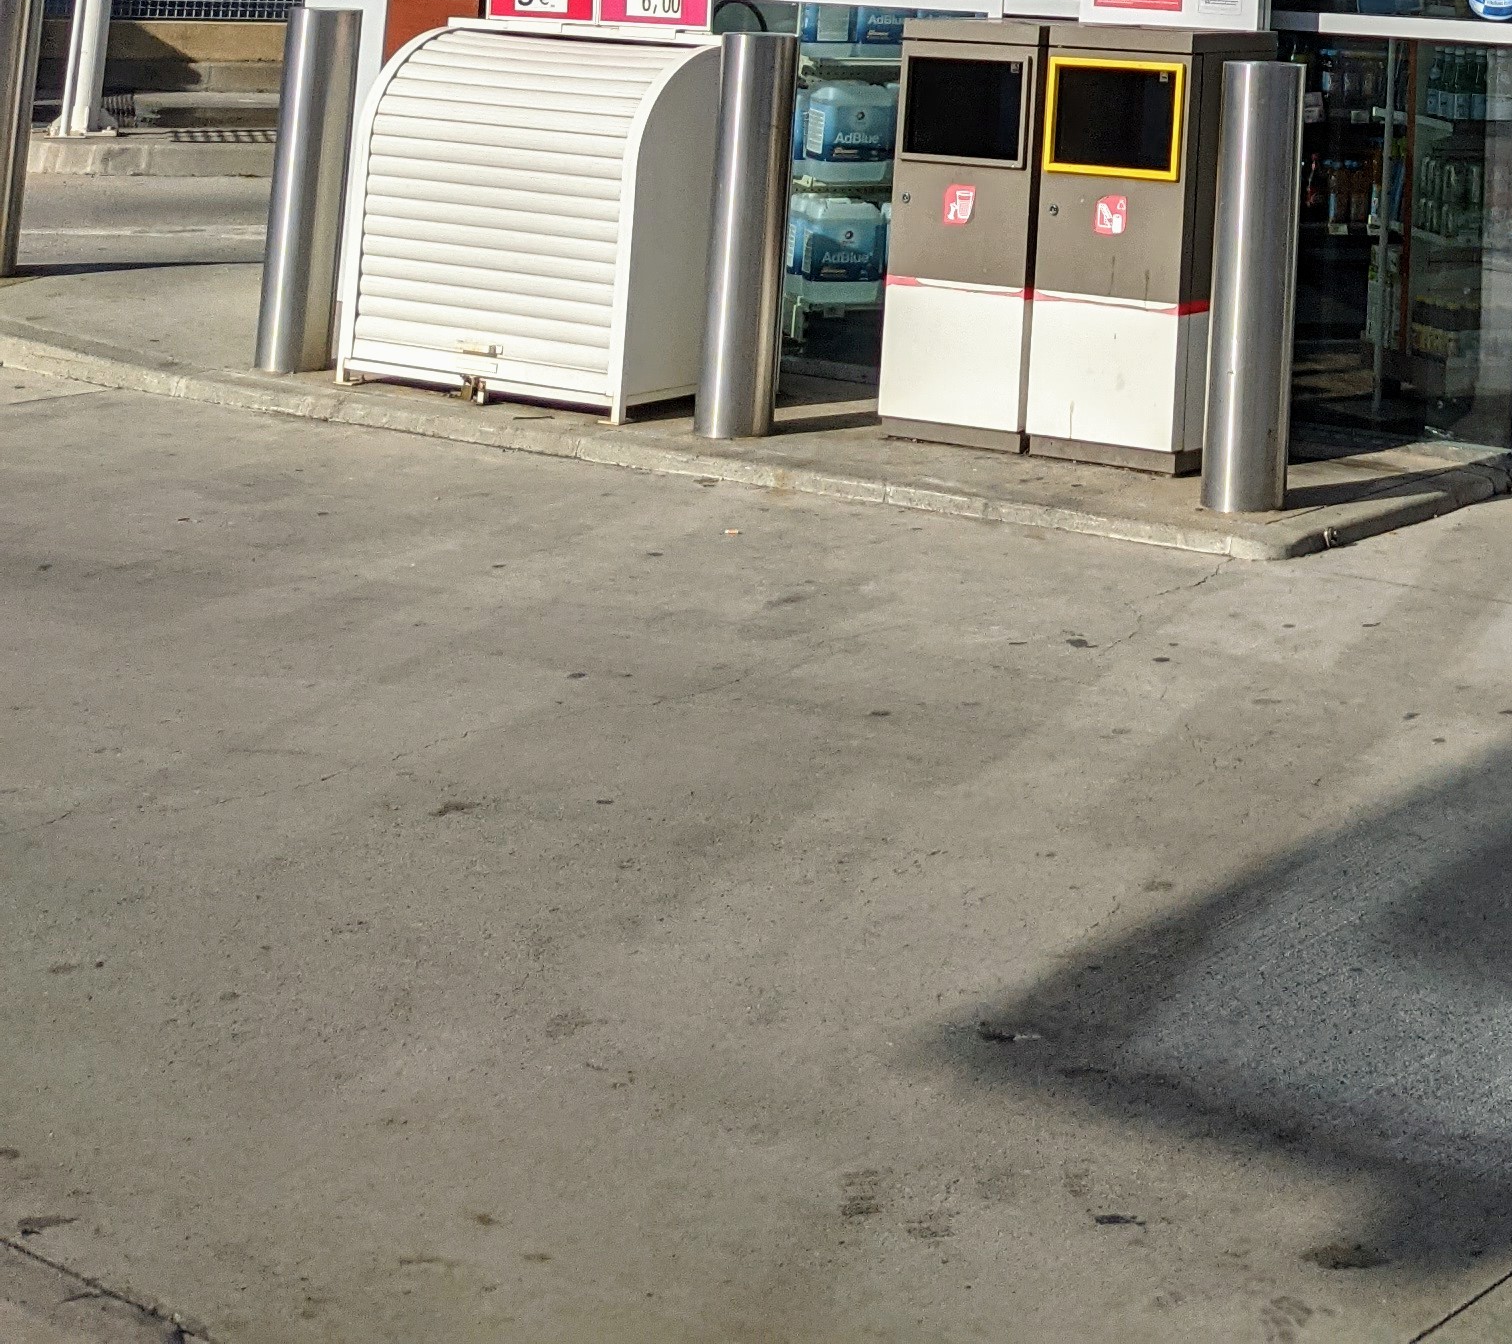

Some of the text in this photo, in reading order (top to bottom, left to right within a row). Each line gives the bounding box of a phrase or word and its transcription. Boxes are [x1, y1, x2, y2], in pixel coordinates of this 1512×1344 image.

[867, 14, 903, 25] AdBlu
[834, 132, 881, 145] AdBlue
[822, 251, 870, 264] AdBlue
